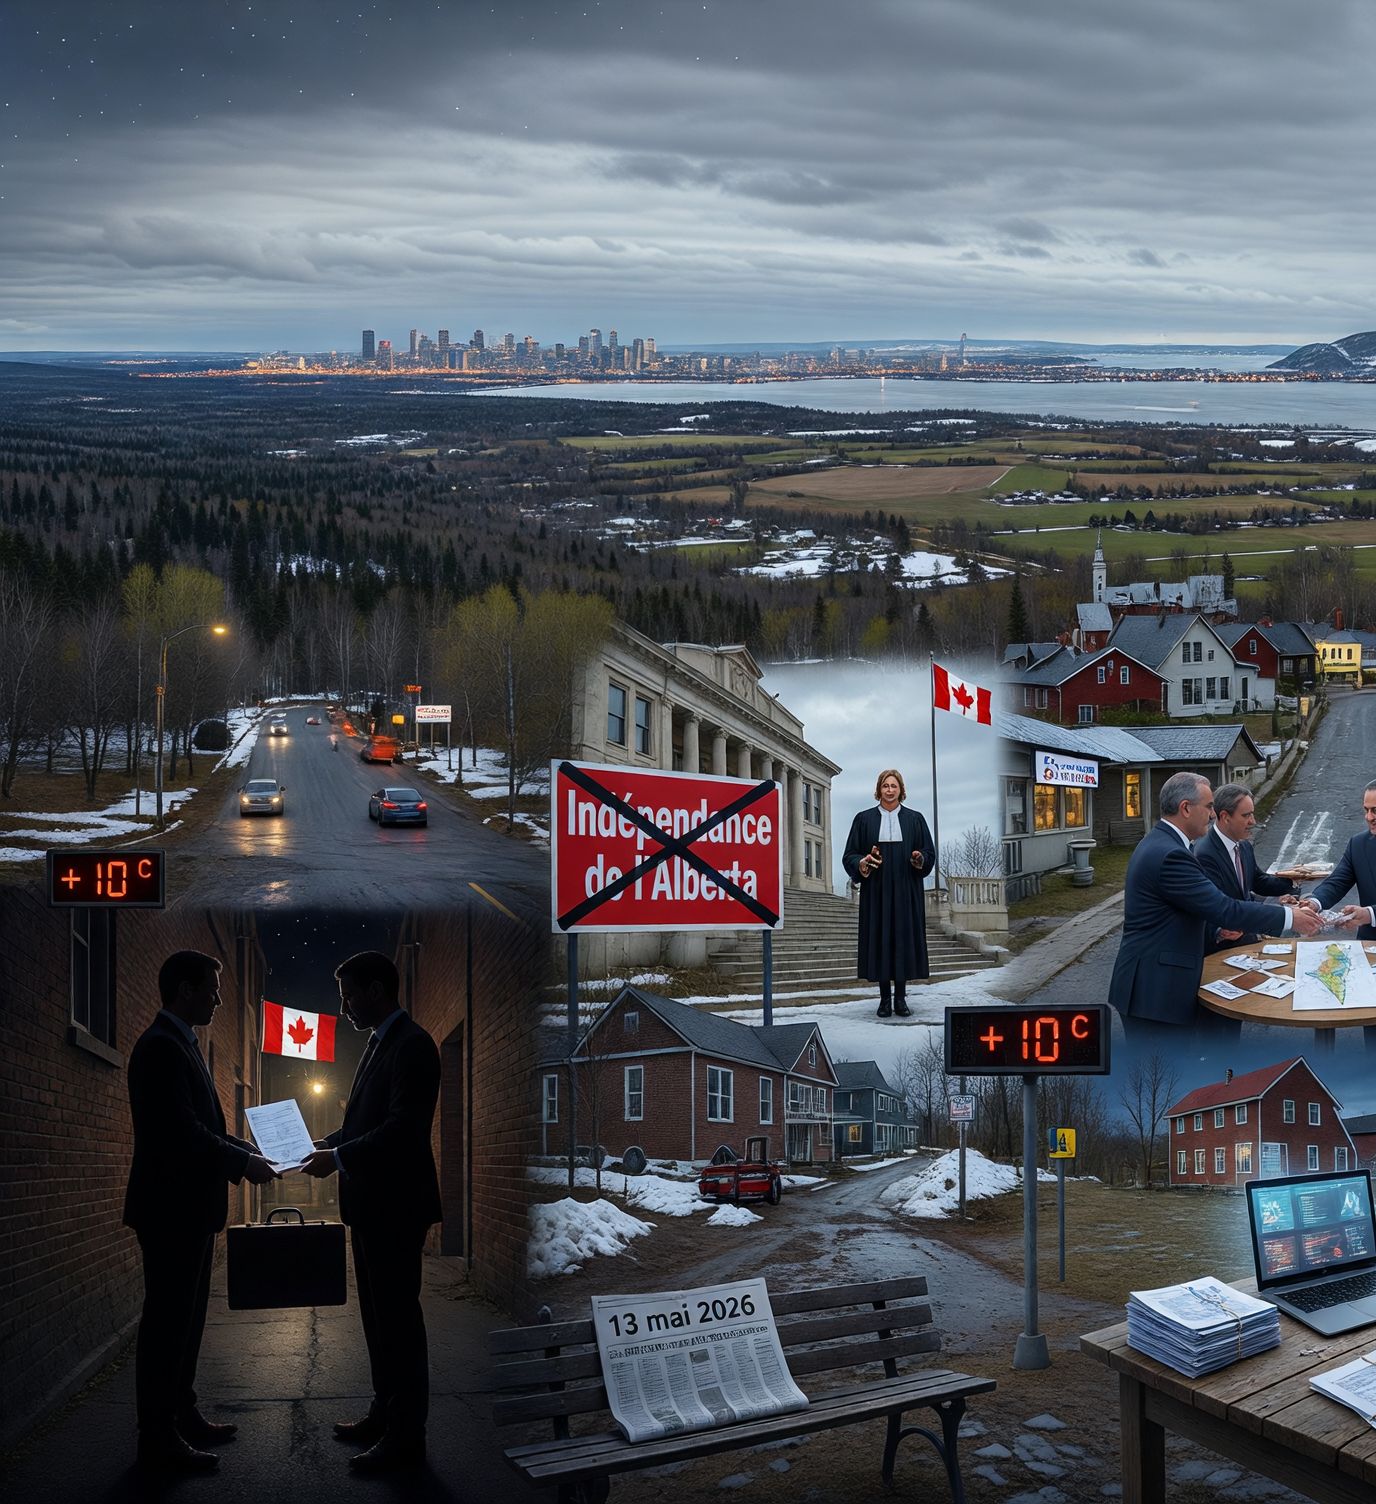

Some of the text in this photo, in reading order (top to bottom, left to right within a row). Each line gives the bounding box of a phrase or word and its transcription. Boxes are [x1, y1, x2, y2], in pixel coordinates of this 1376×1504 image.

[567, 789, 772, 850] Indépendance
[584, 854, 624, 901] de
[608, 1294, 756, 1337] 13 mai 2026
